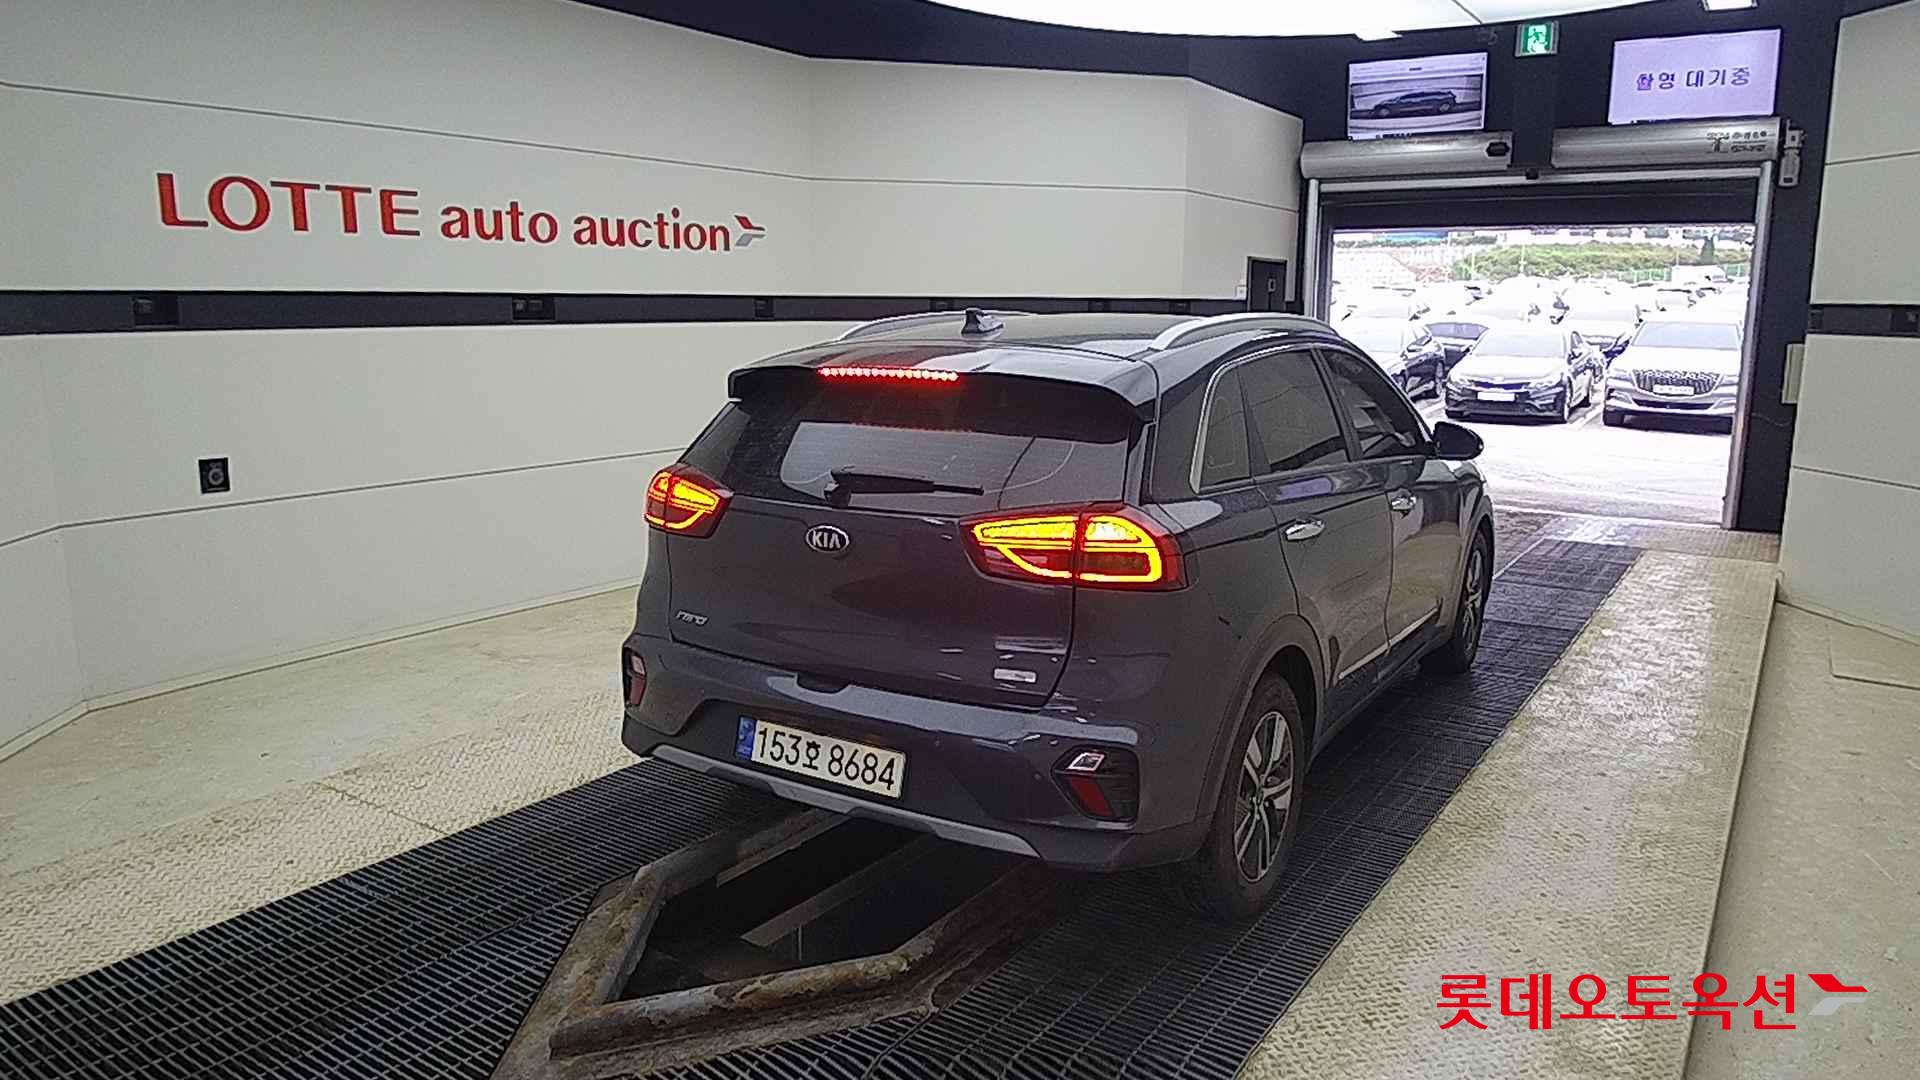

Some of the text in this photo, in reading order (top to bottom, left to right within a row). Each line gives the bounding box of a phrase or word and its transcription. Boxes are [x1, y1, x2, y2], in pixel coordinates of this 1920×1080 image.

[1685, 67, 1750, 87] 대기중
[156, 173, 731, 251] LOTTE auto auction
[811, 530, 842, 549] KIA
[828, 744, 895, 791] 8684
